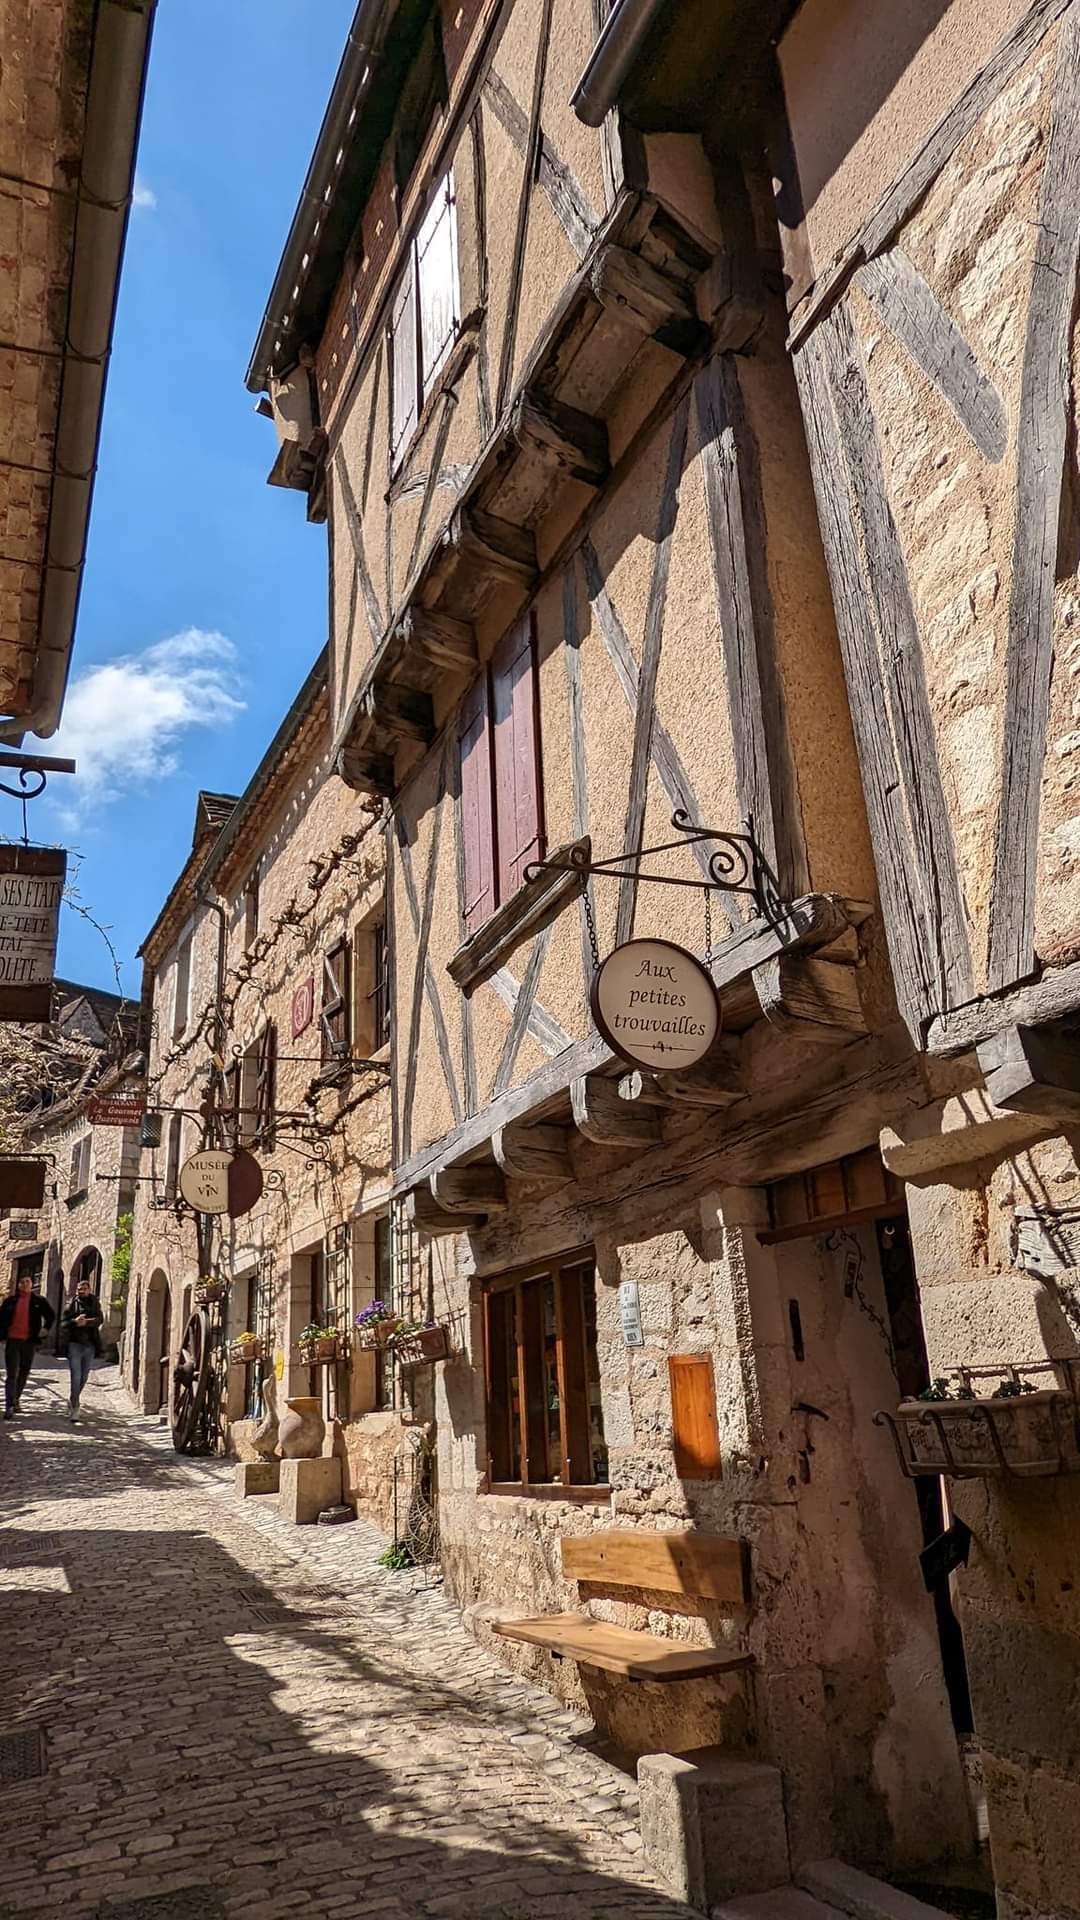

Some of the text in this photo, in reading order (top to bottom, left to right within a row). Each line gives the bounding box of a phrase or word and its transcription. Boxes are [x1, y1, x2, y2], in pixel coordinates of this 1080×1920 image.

[1, 880, 24, 906] SES
[635, 959, 678, 983] Aux
[628, 987, 687, 1008] petites
[614, 1013, 706, 1036] trouvailles
